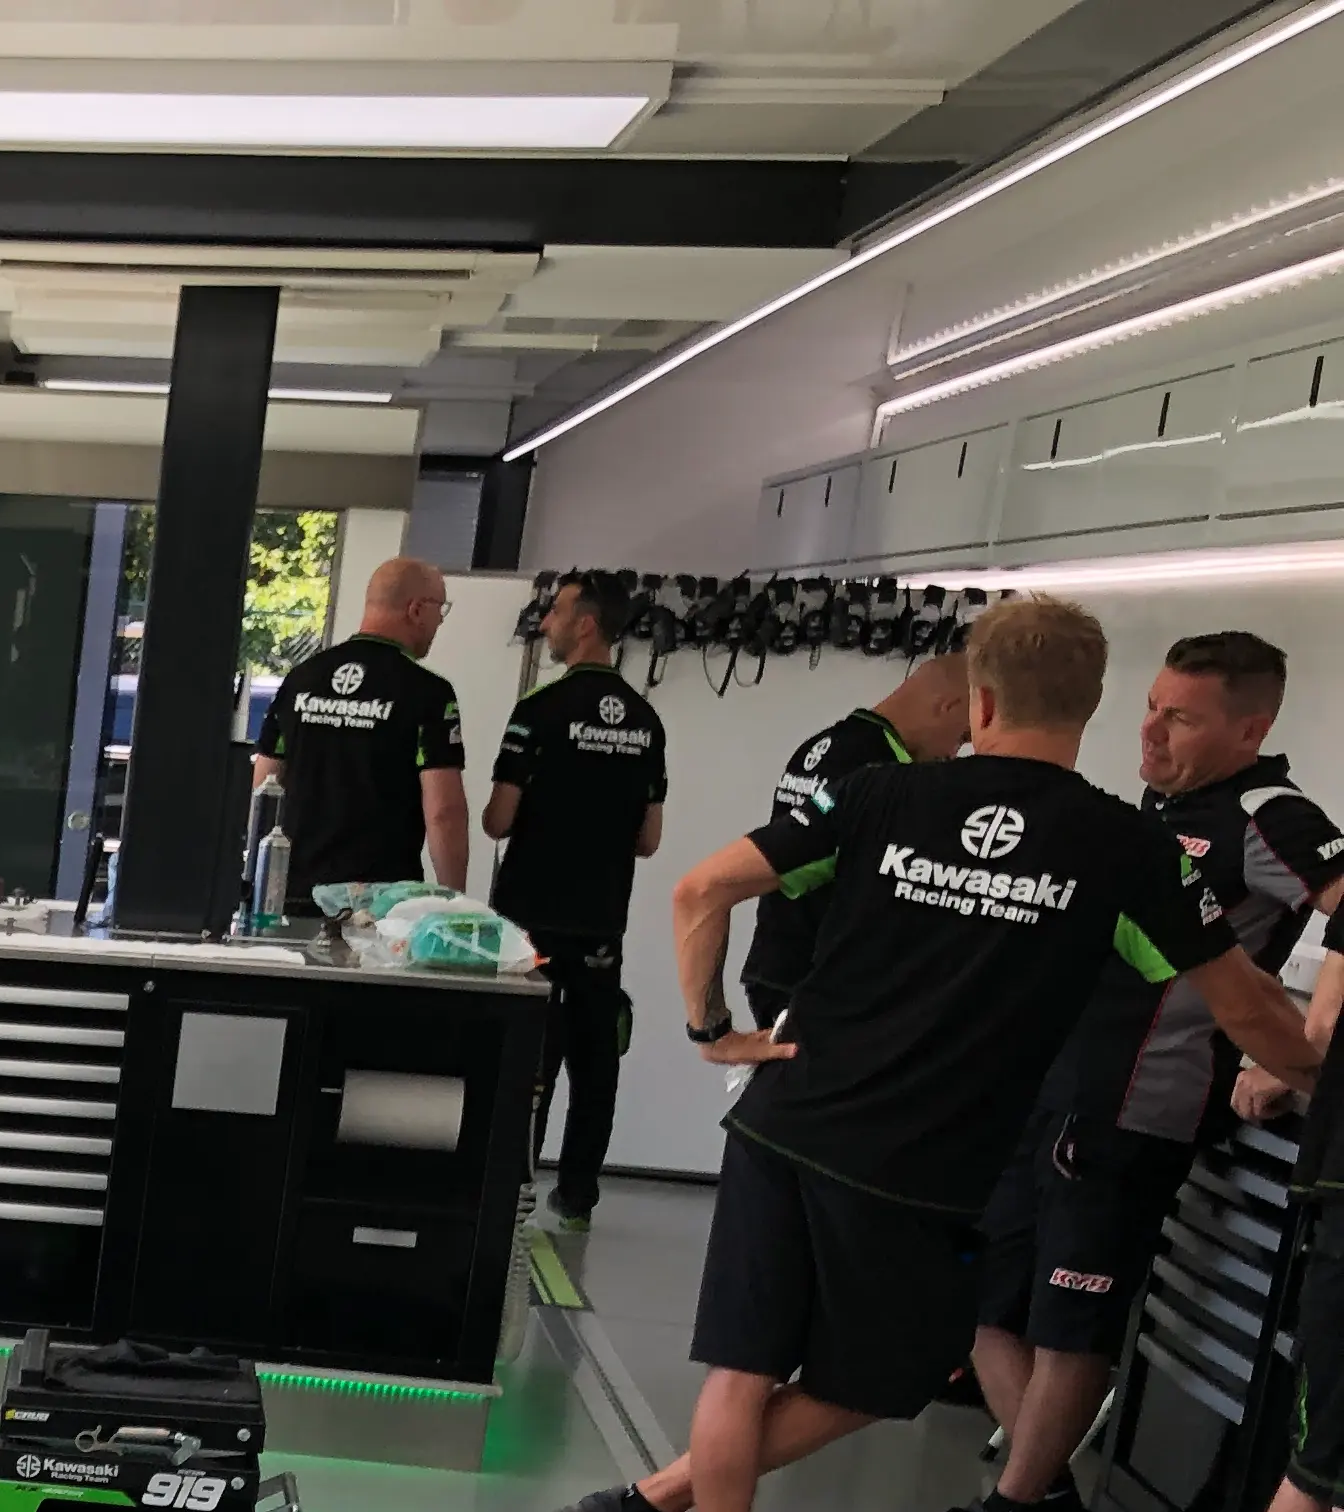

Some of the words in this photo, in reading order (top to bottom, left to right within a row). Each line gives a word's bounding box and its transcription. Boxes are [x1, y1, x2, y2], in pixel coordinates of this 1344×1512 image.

[294, 692, 393, 721] Kawasaki
[301, 713, 342, 729] Racing
[344, 716, 375, 730] Team
[569, 721, 652, 748] Kawasaki
[879, 842, 1078, 911] Kawasaki
[894, 880, 976, 916] Racing
[980, 897, 1041, 924] Team
[42, 1457, 119, 1478] Kawasaki
[50, 1471, 83, 1483] Racing
[85, 1474, 109, 1485] Team
[141, 1472, 227, 1512] 919
